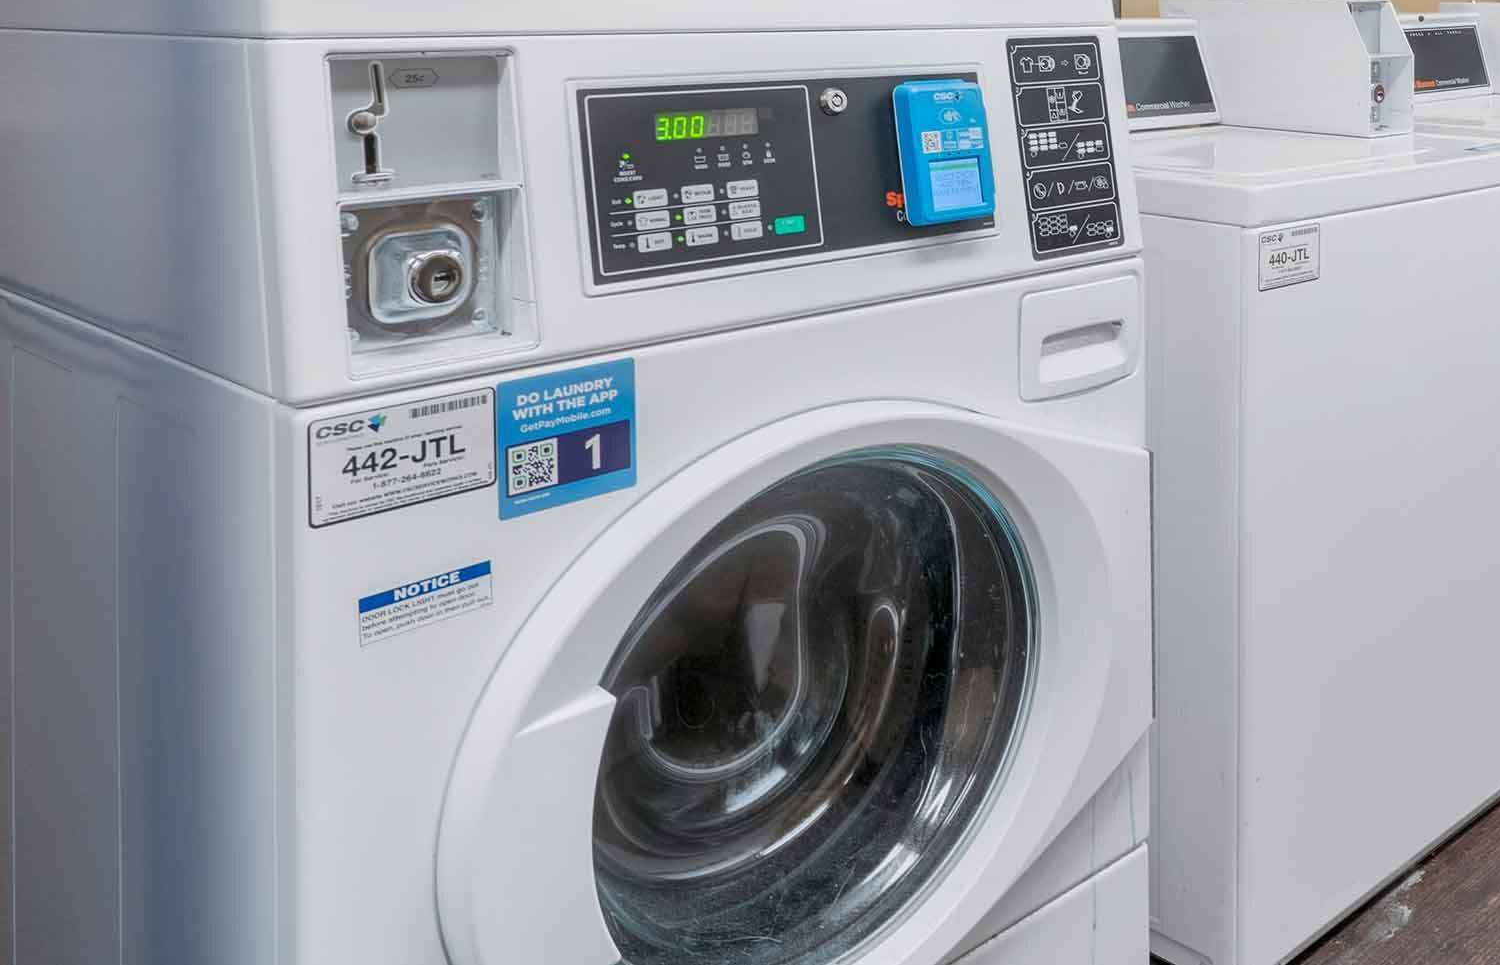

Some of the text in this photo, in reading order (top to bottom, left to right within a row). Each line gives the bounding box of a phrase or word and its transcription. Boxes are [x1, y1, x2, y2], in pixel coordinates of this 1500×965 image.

[656, 115, 704, 141] 3.00
[885, 191, 904, 209] Sp
[1269, 248, 1310, 266] 440-JTL
[516, 377, 614, 406] DO LAUNDRY
[512, 390, 618, 421] WITH THE APP
[315, 419, 365, 440] CSC
[520, 407, 611, 433] GetPayMobile.com
[342, 434, 466, 477] 442-JTL
[585, 434, 601, 470] 1
[393, 571, 461, 602] NOTICE
